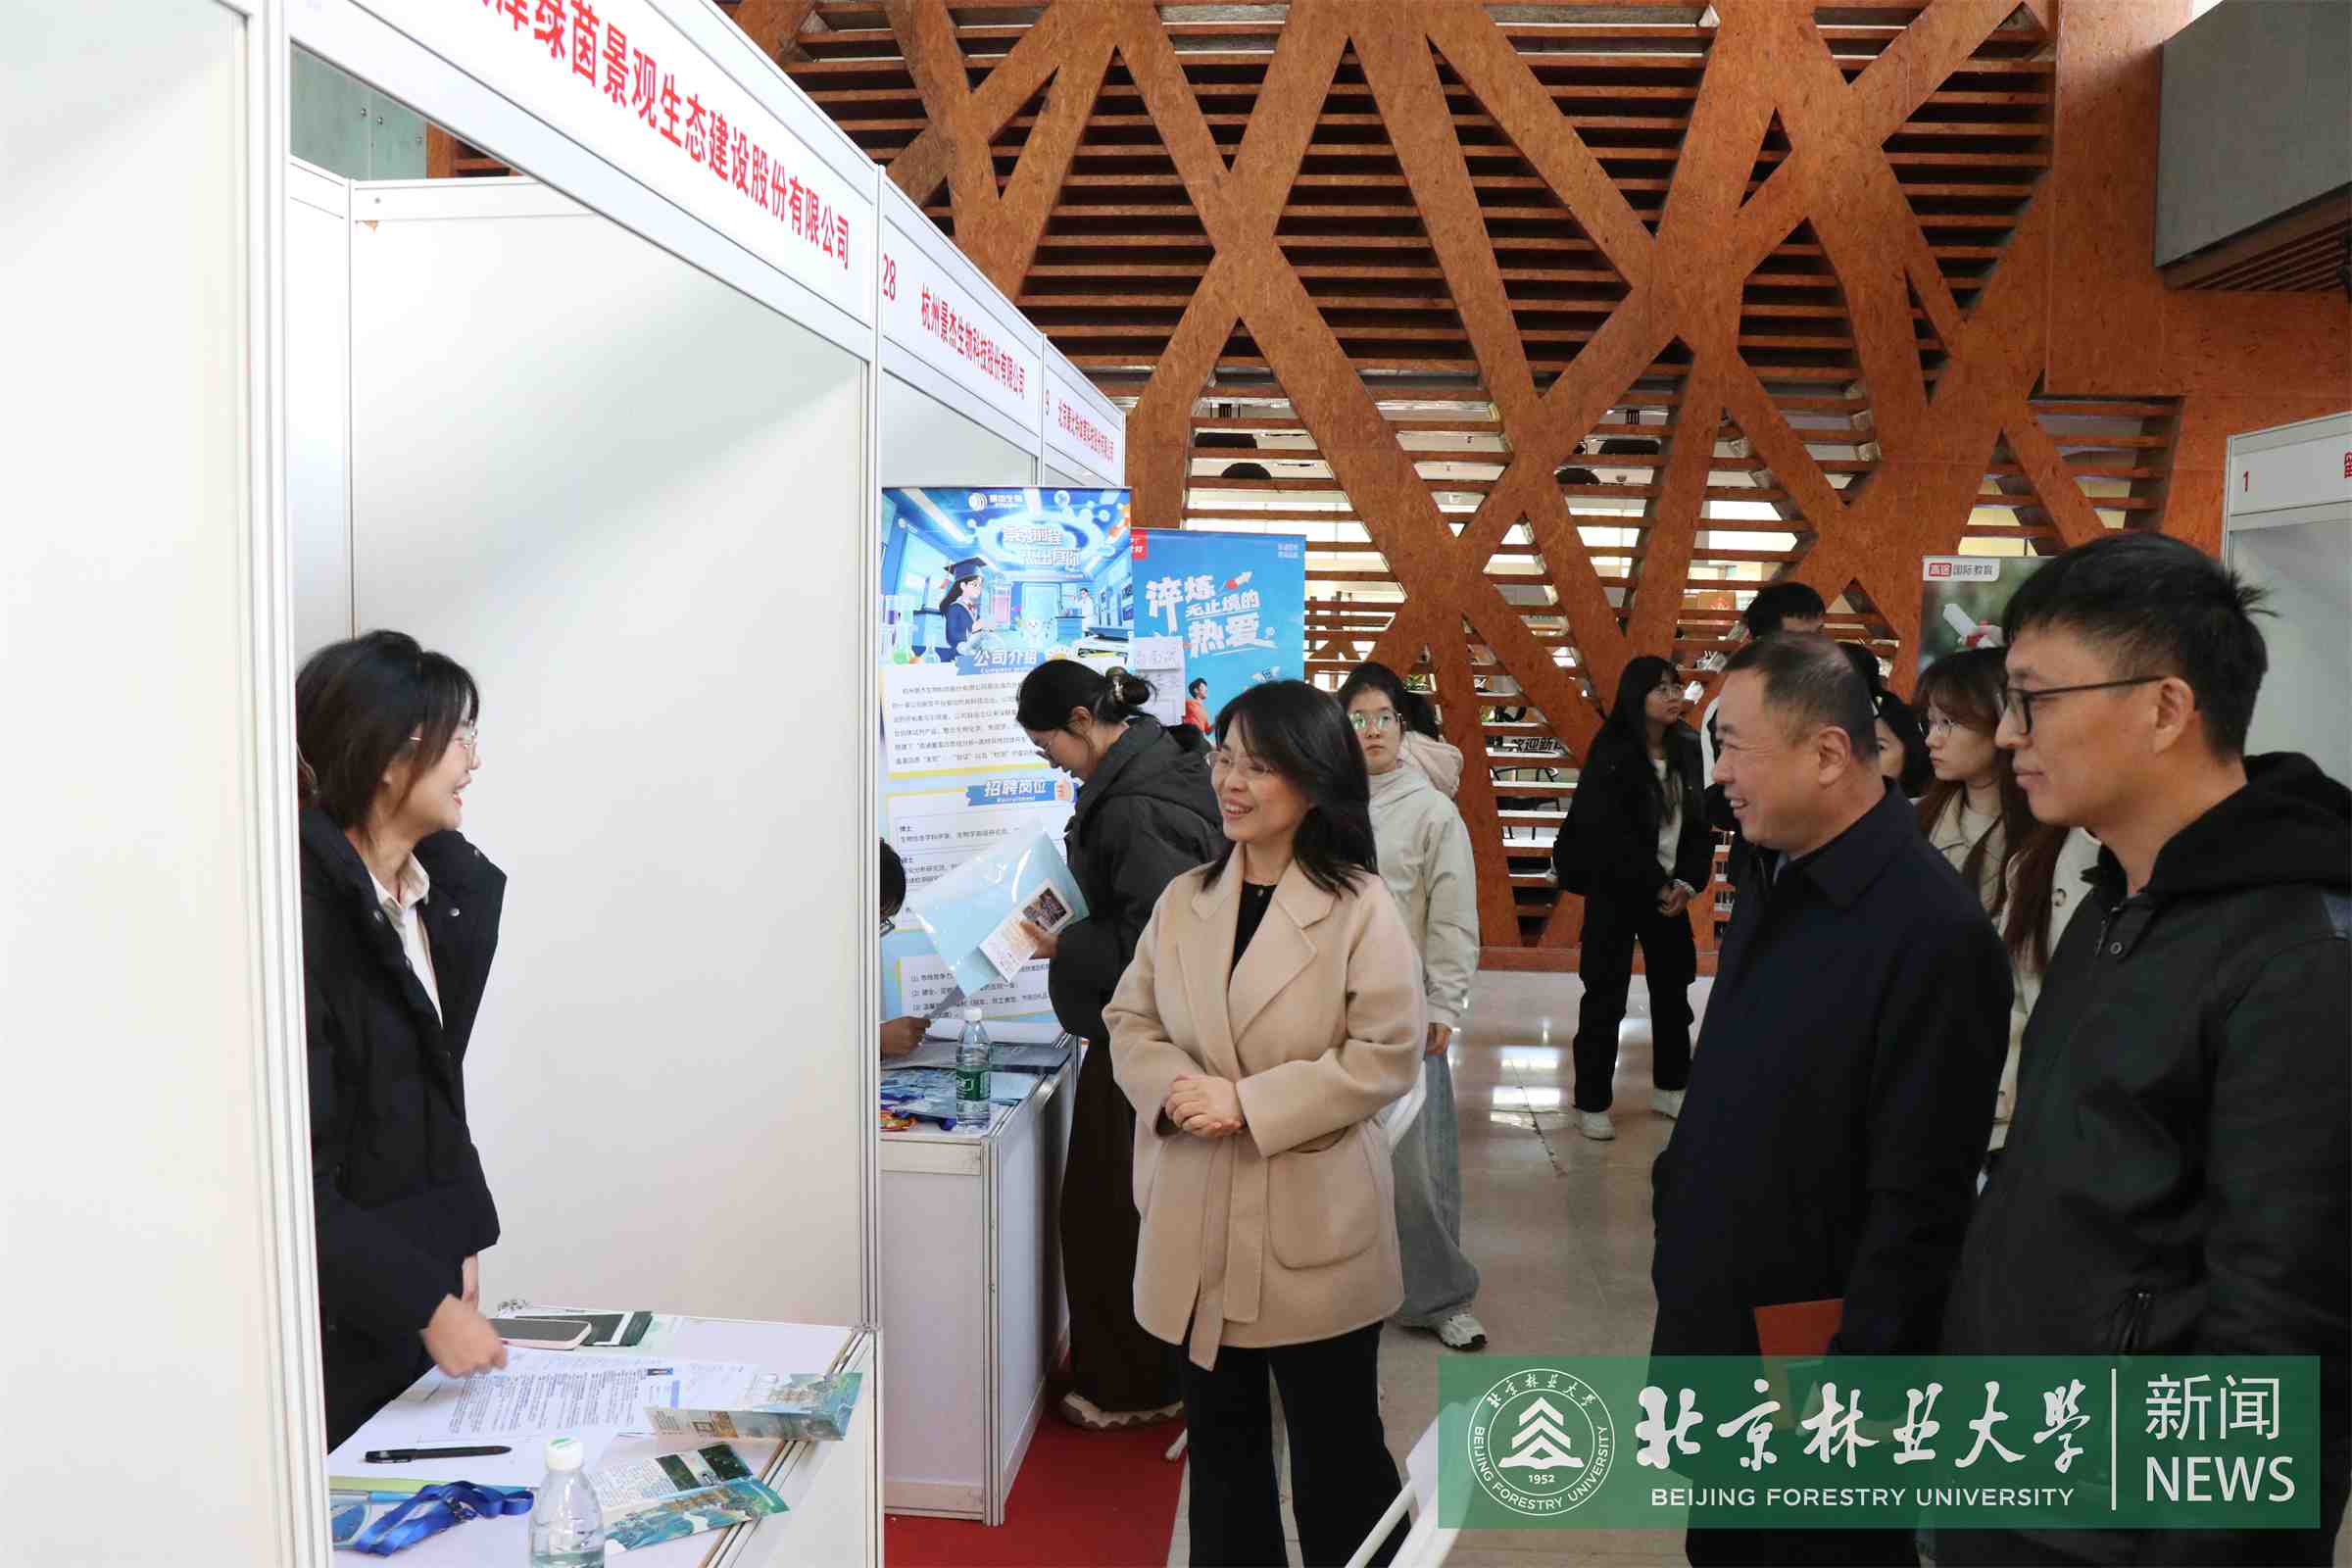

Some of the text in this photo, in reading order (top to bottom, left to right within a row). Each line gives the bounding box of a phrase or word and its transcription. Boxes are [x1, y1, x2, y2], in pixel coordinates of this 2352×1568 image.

[882, 253, 896, 301] 28
[2243, 470, 2249, 493] 1
[1189, 612, 1263, 659] 热爱
